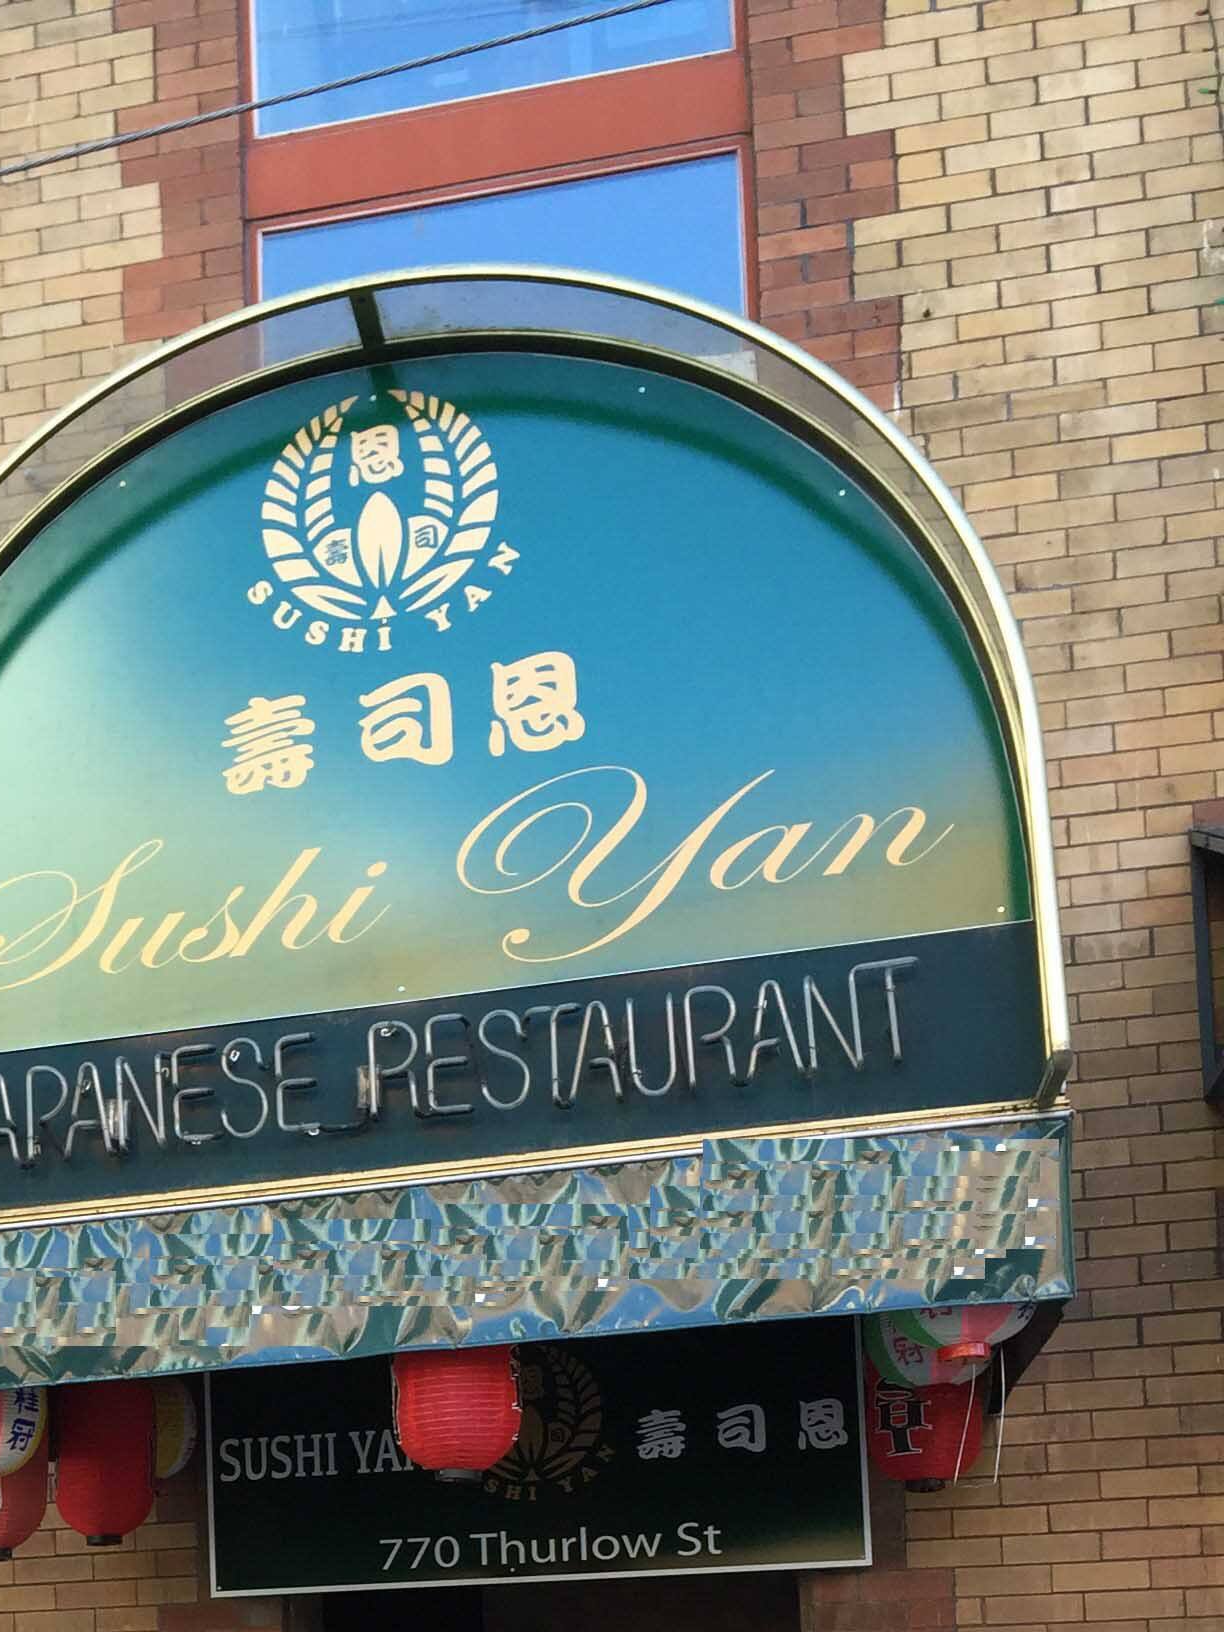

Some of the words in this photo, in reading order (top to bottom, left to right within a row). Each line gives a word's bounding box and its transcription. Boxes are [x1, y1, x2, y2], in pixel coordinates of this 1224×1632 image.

[248, 580, 392, 652] SUSHI
[424, 542, 520, 631] YAN
[454, 764, 954, 963] Yan
[354, 955, 921, 1118] RESTAURANT
[219, 1433, 337, 1482] SUSHI
[378, 1536, 461, 1571] 770
[470, 1529, 664, 1567] Thurlow
[675, 1521, 723, 1556] St
